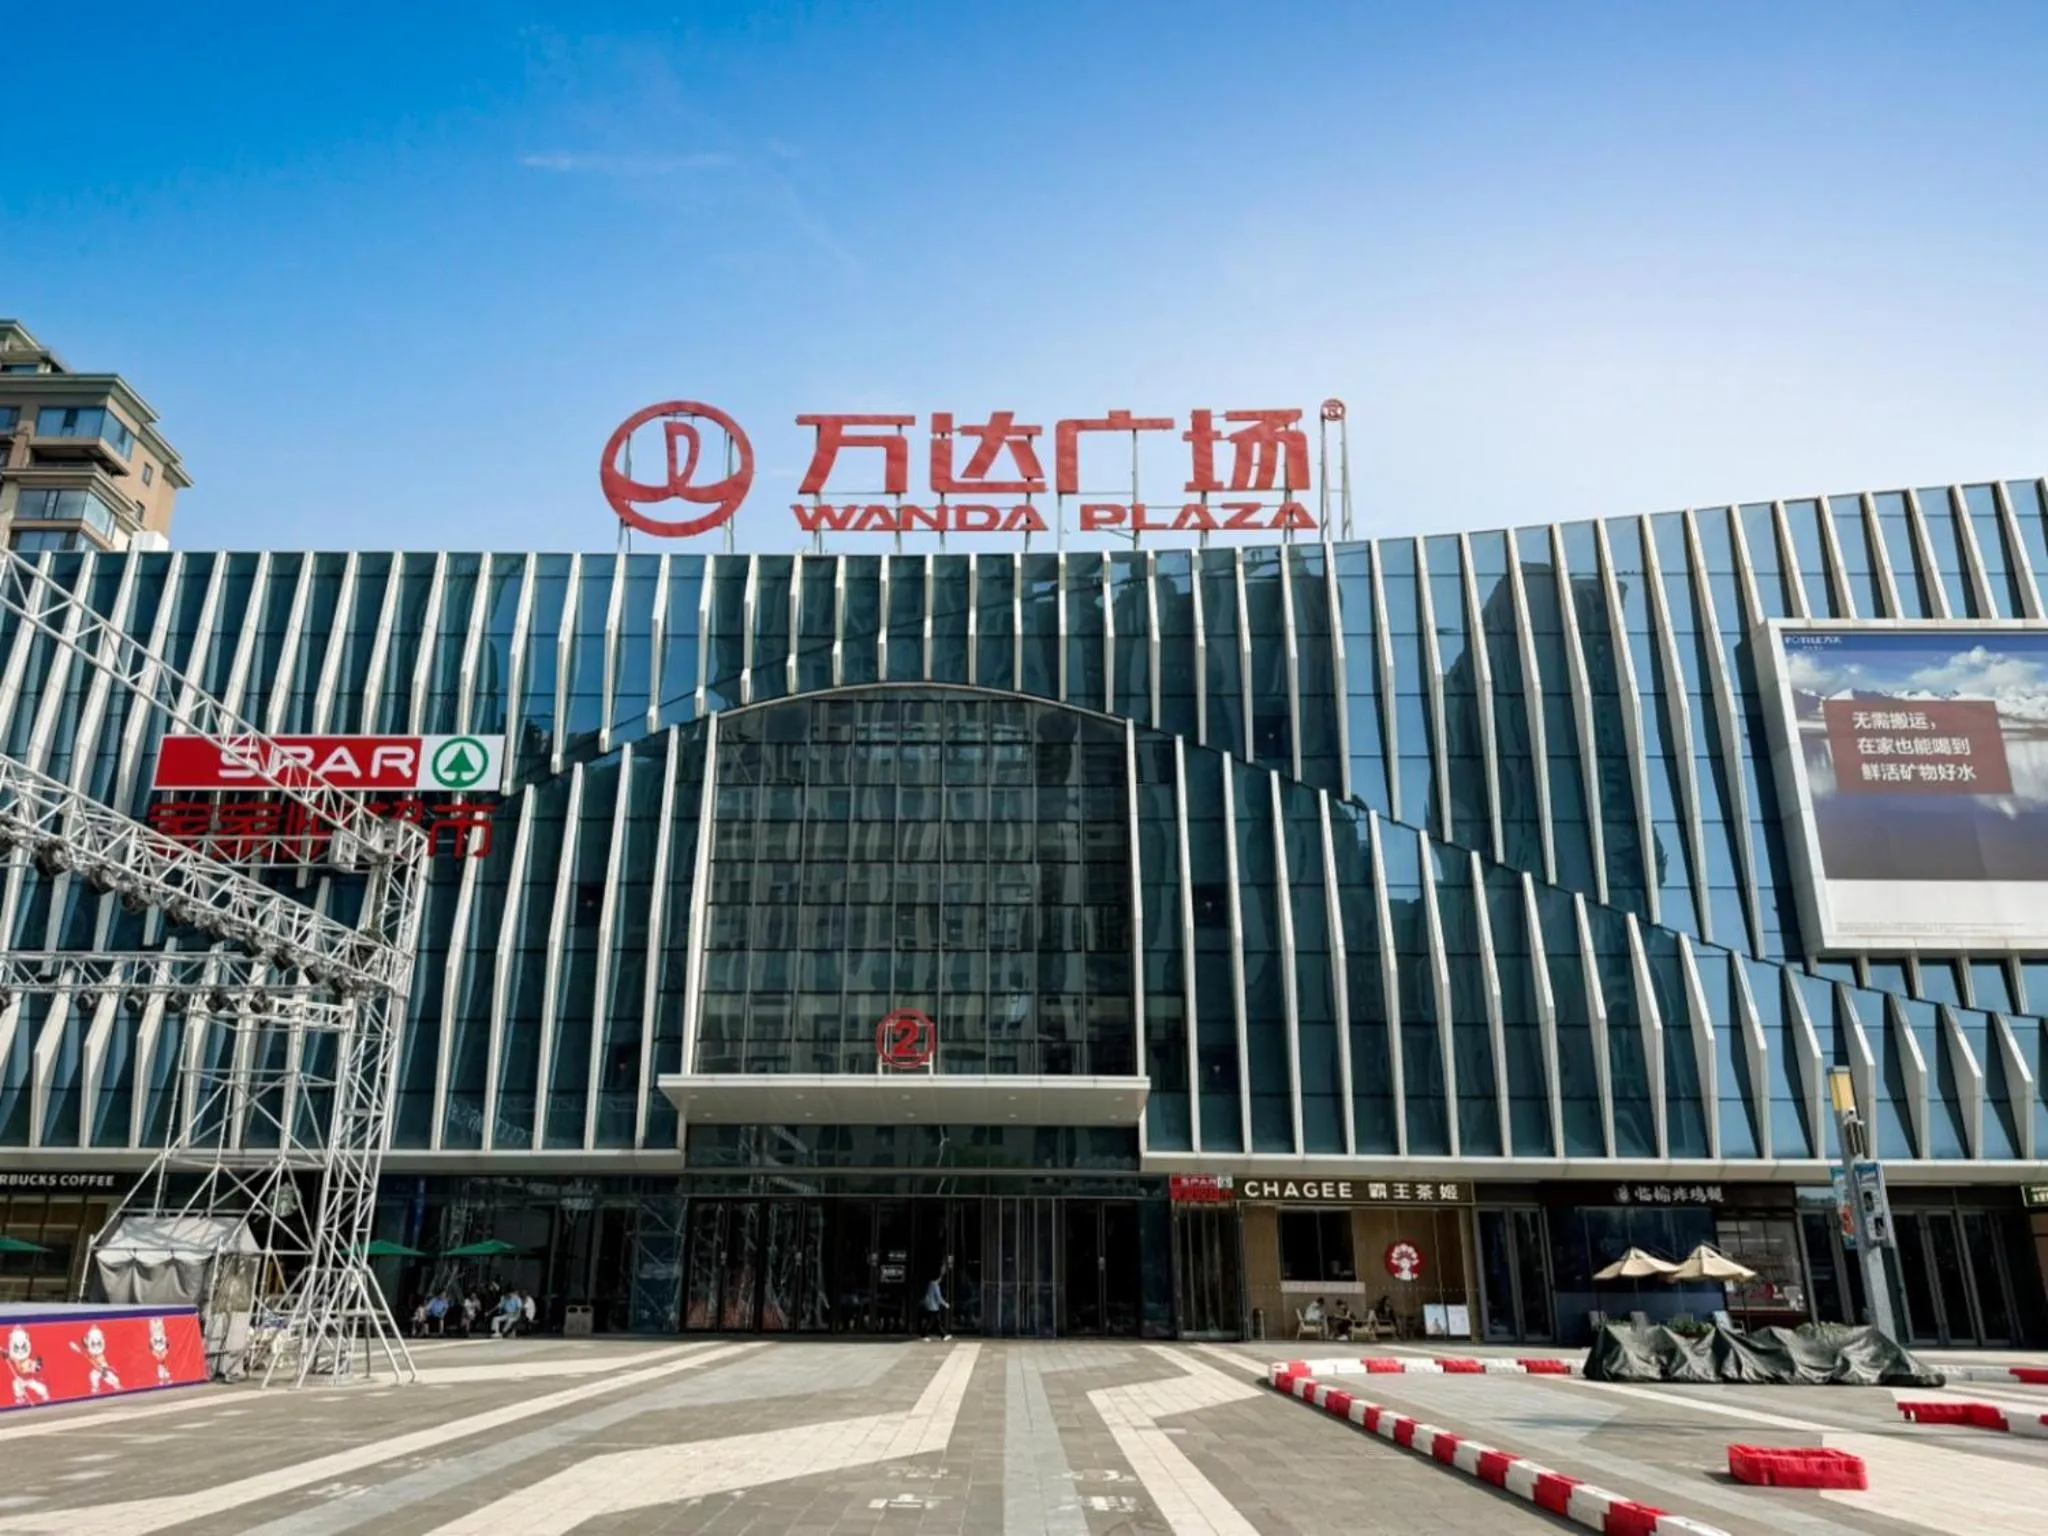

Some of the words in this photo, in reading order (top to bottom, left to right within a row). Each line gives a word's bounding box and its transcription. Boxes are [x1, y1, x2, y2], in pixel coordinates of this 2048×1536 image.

[796, 408, 1311, 494] 万达广场
[791, 503, 1050, 531] WANDA
[1079, 501, 1320, 531] PLAZA
[1857, 737, 1971, 756] 在家也能喝到
[218, 744, 416, 779] SPAR
[1861, 763, 1976, 781] 鲜活矿物好水
[893, 1019, 919, 1057] 2
[60, 1174, 115, 1187] COFFEE
[1244, 1180, 1353, 1199] CHAGEE
[1368, 1182, 1460, 1201] 霸王茶姬
